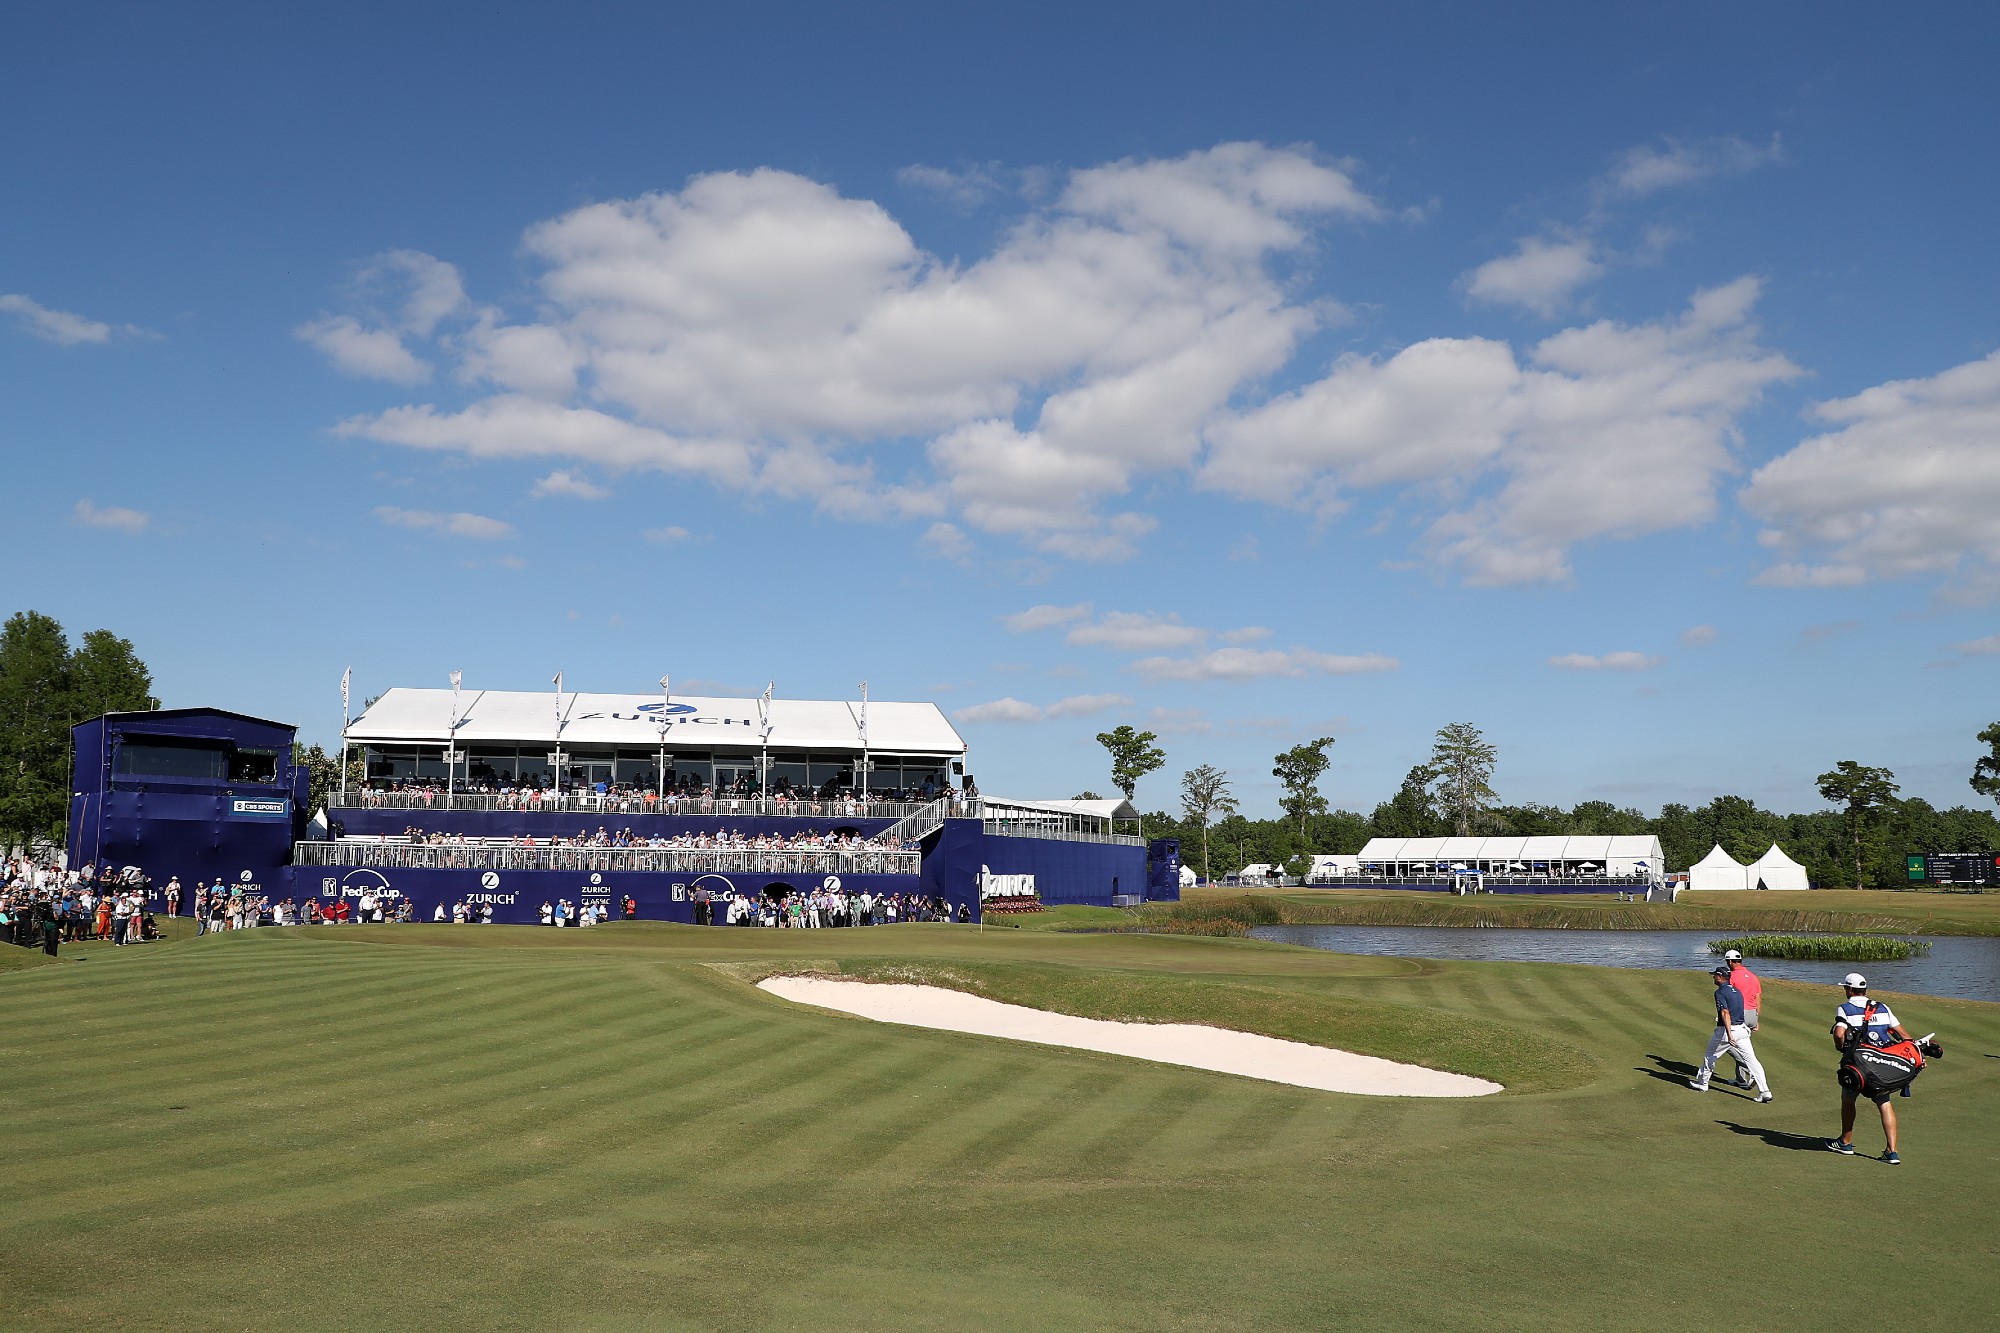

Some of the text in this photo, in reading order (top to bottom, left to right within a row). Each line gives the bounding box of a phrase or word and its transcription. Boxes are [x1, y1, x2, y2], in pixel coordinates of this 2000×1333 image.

[578, 713, 750, 726] ZURICH
[230, 883, 261, 891] ZRICH
[466, 893, 515, 905] ZURICH
